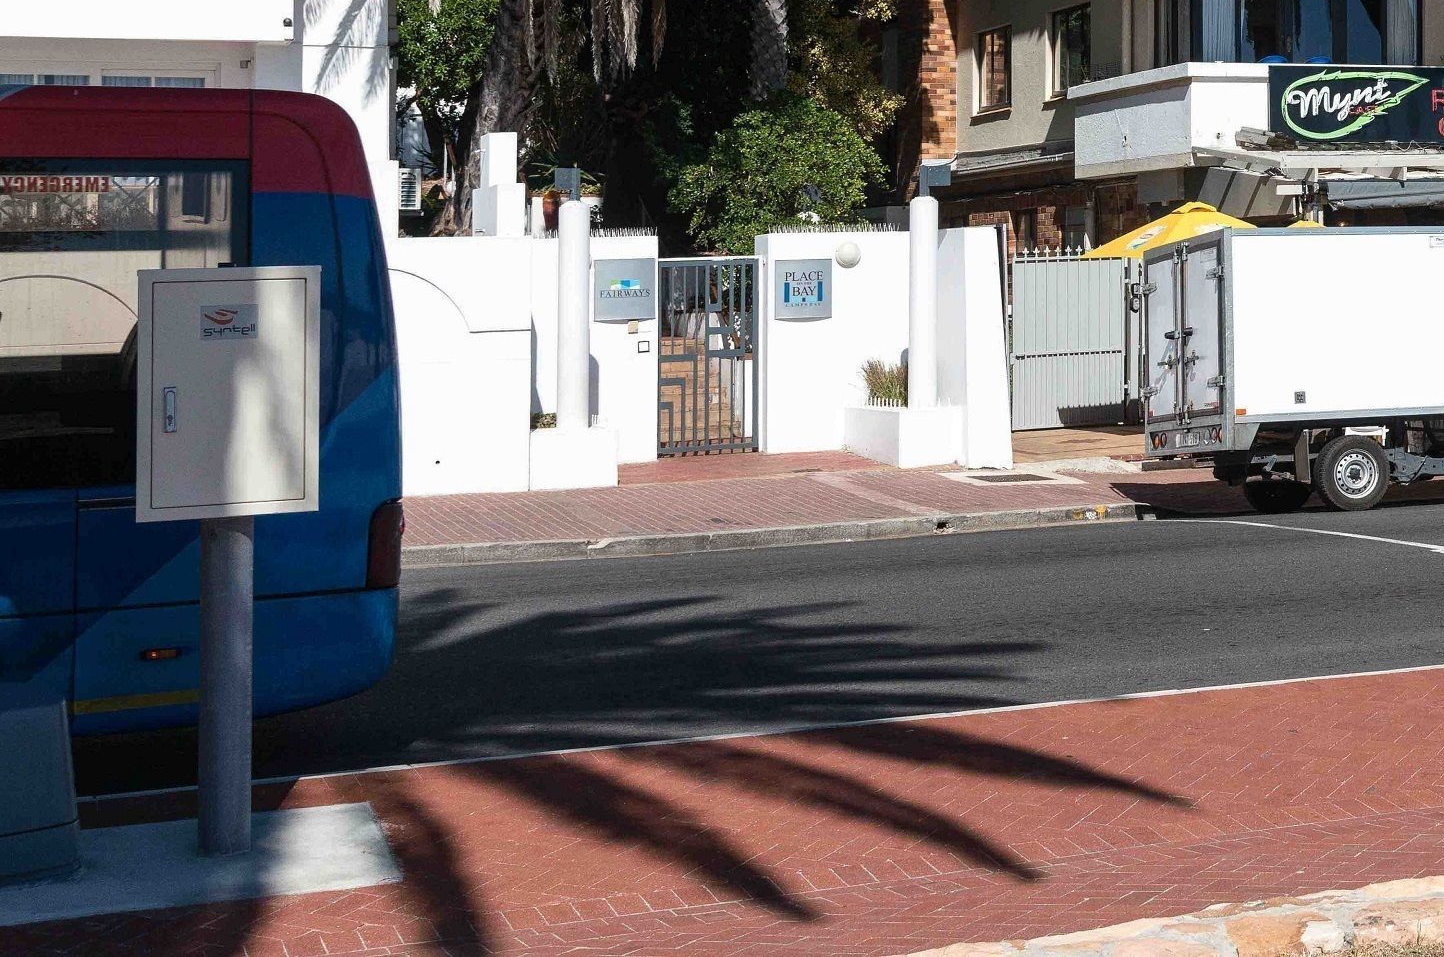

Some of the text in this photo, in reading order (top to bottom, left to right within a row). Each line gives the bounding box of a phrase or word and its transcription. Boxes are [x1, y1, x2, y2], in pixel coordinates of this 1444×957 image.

[1287, 77, 1391, 121] Mynt
[785, 271, 824, 281] PLACE
[600, 289, 651, 298] FAIRWAYS
[792, 285, 816, 296] BAY
